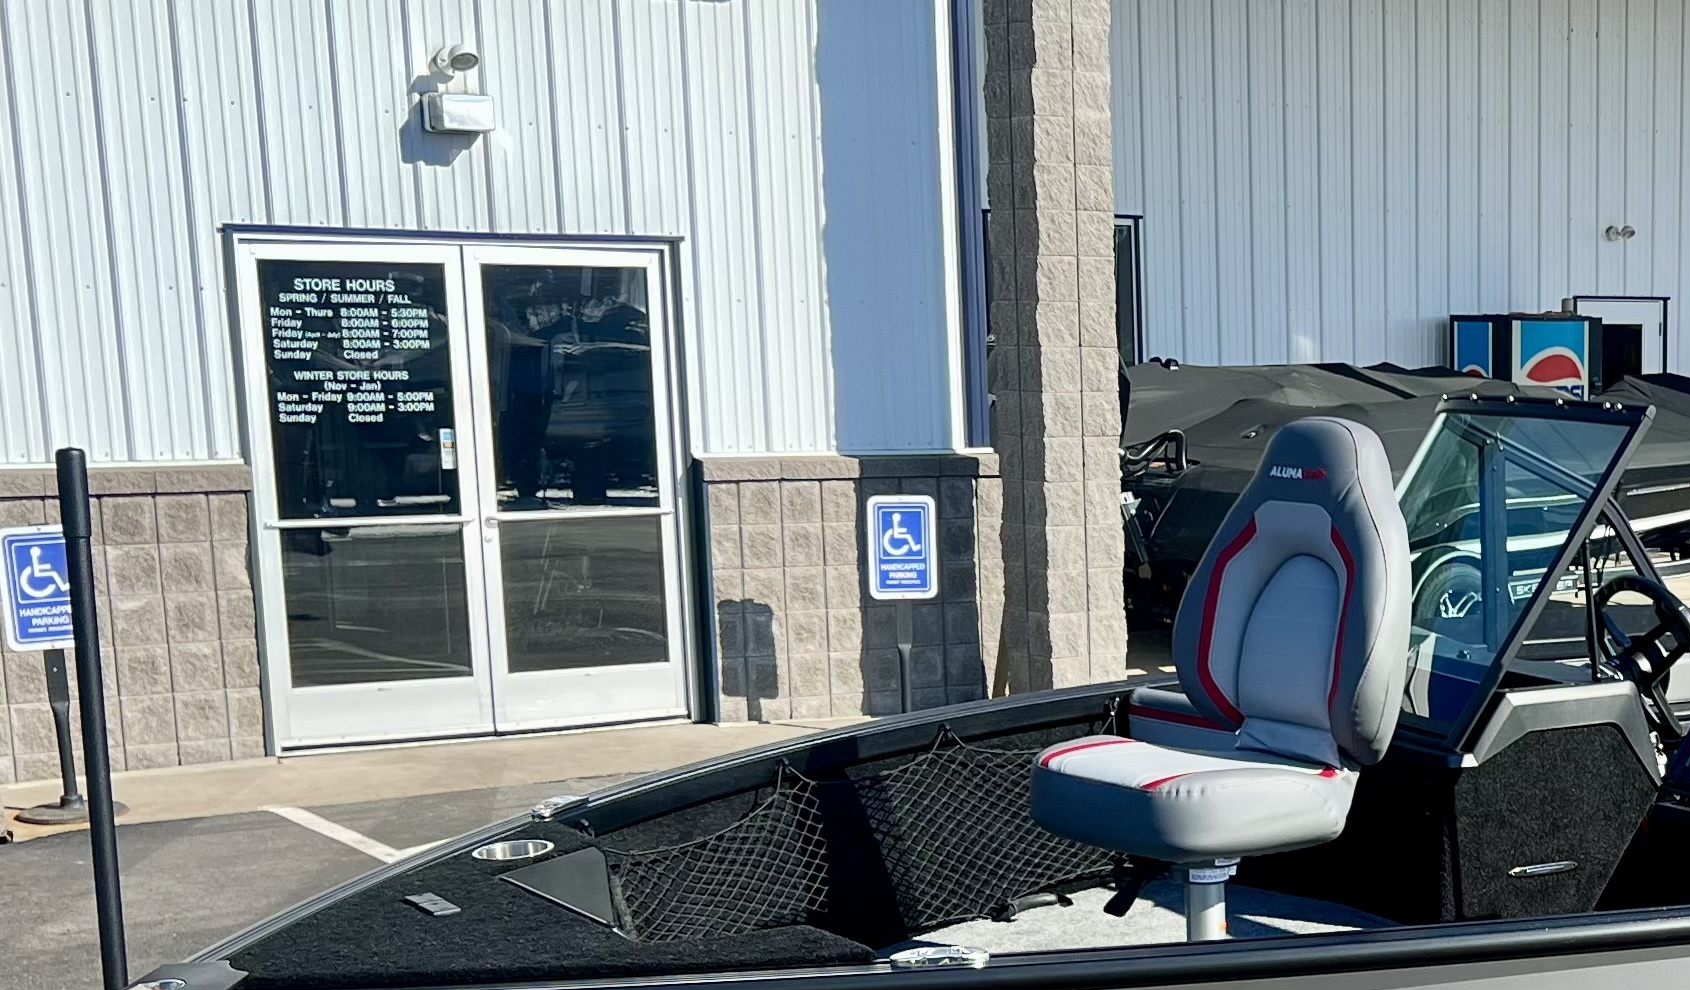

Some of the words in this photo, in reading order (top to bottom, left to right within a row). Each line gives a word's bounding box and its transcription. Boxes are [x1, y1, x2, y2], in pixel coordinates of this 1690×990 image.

[294, 278, 341, 292] STORE
[346, 279, 395, 292] HOURS
[279, 293, 318, 303] SPRING
[321, 293, 326, 304] /
[330, 294, 375, 304] SUMMER
[379, 294, 384, 304] /
[387, 294, 412, 304] FALL
[270, 307, 293, 316] Mon
[304, 307, 333, 317] Thurs
[271, 318, 302, 329] Friday
[272, 329, 303, 339] Friday
[392, 329, 429, 338] 7:00PM
[273, 339, 318, 350] Saturday
[274, 350, 312, 360] Sunday
[344, 350, 378, 359] Closed
[294, 371, 333, 380] WINTER
[337, 371, 370, 380] STORE
[373, 371, 409, 380] HOURS
[324, 381, 347, 391] (Nov
[359, 381, 381, 391] Jan)
[277, 392, 299, 401] Mon
[311, 392, 342, 403] Friday
[278, 402, 323, 413] Saturday
[279, 413, 317, 423] Sunday
[348, 413, 383, 422] Closed
[20, 605, 72, 617] HANDICAPP
[32, 615, 70, 626] PARKING
